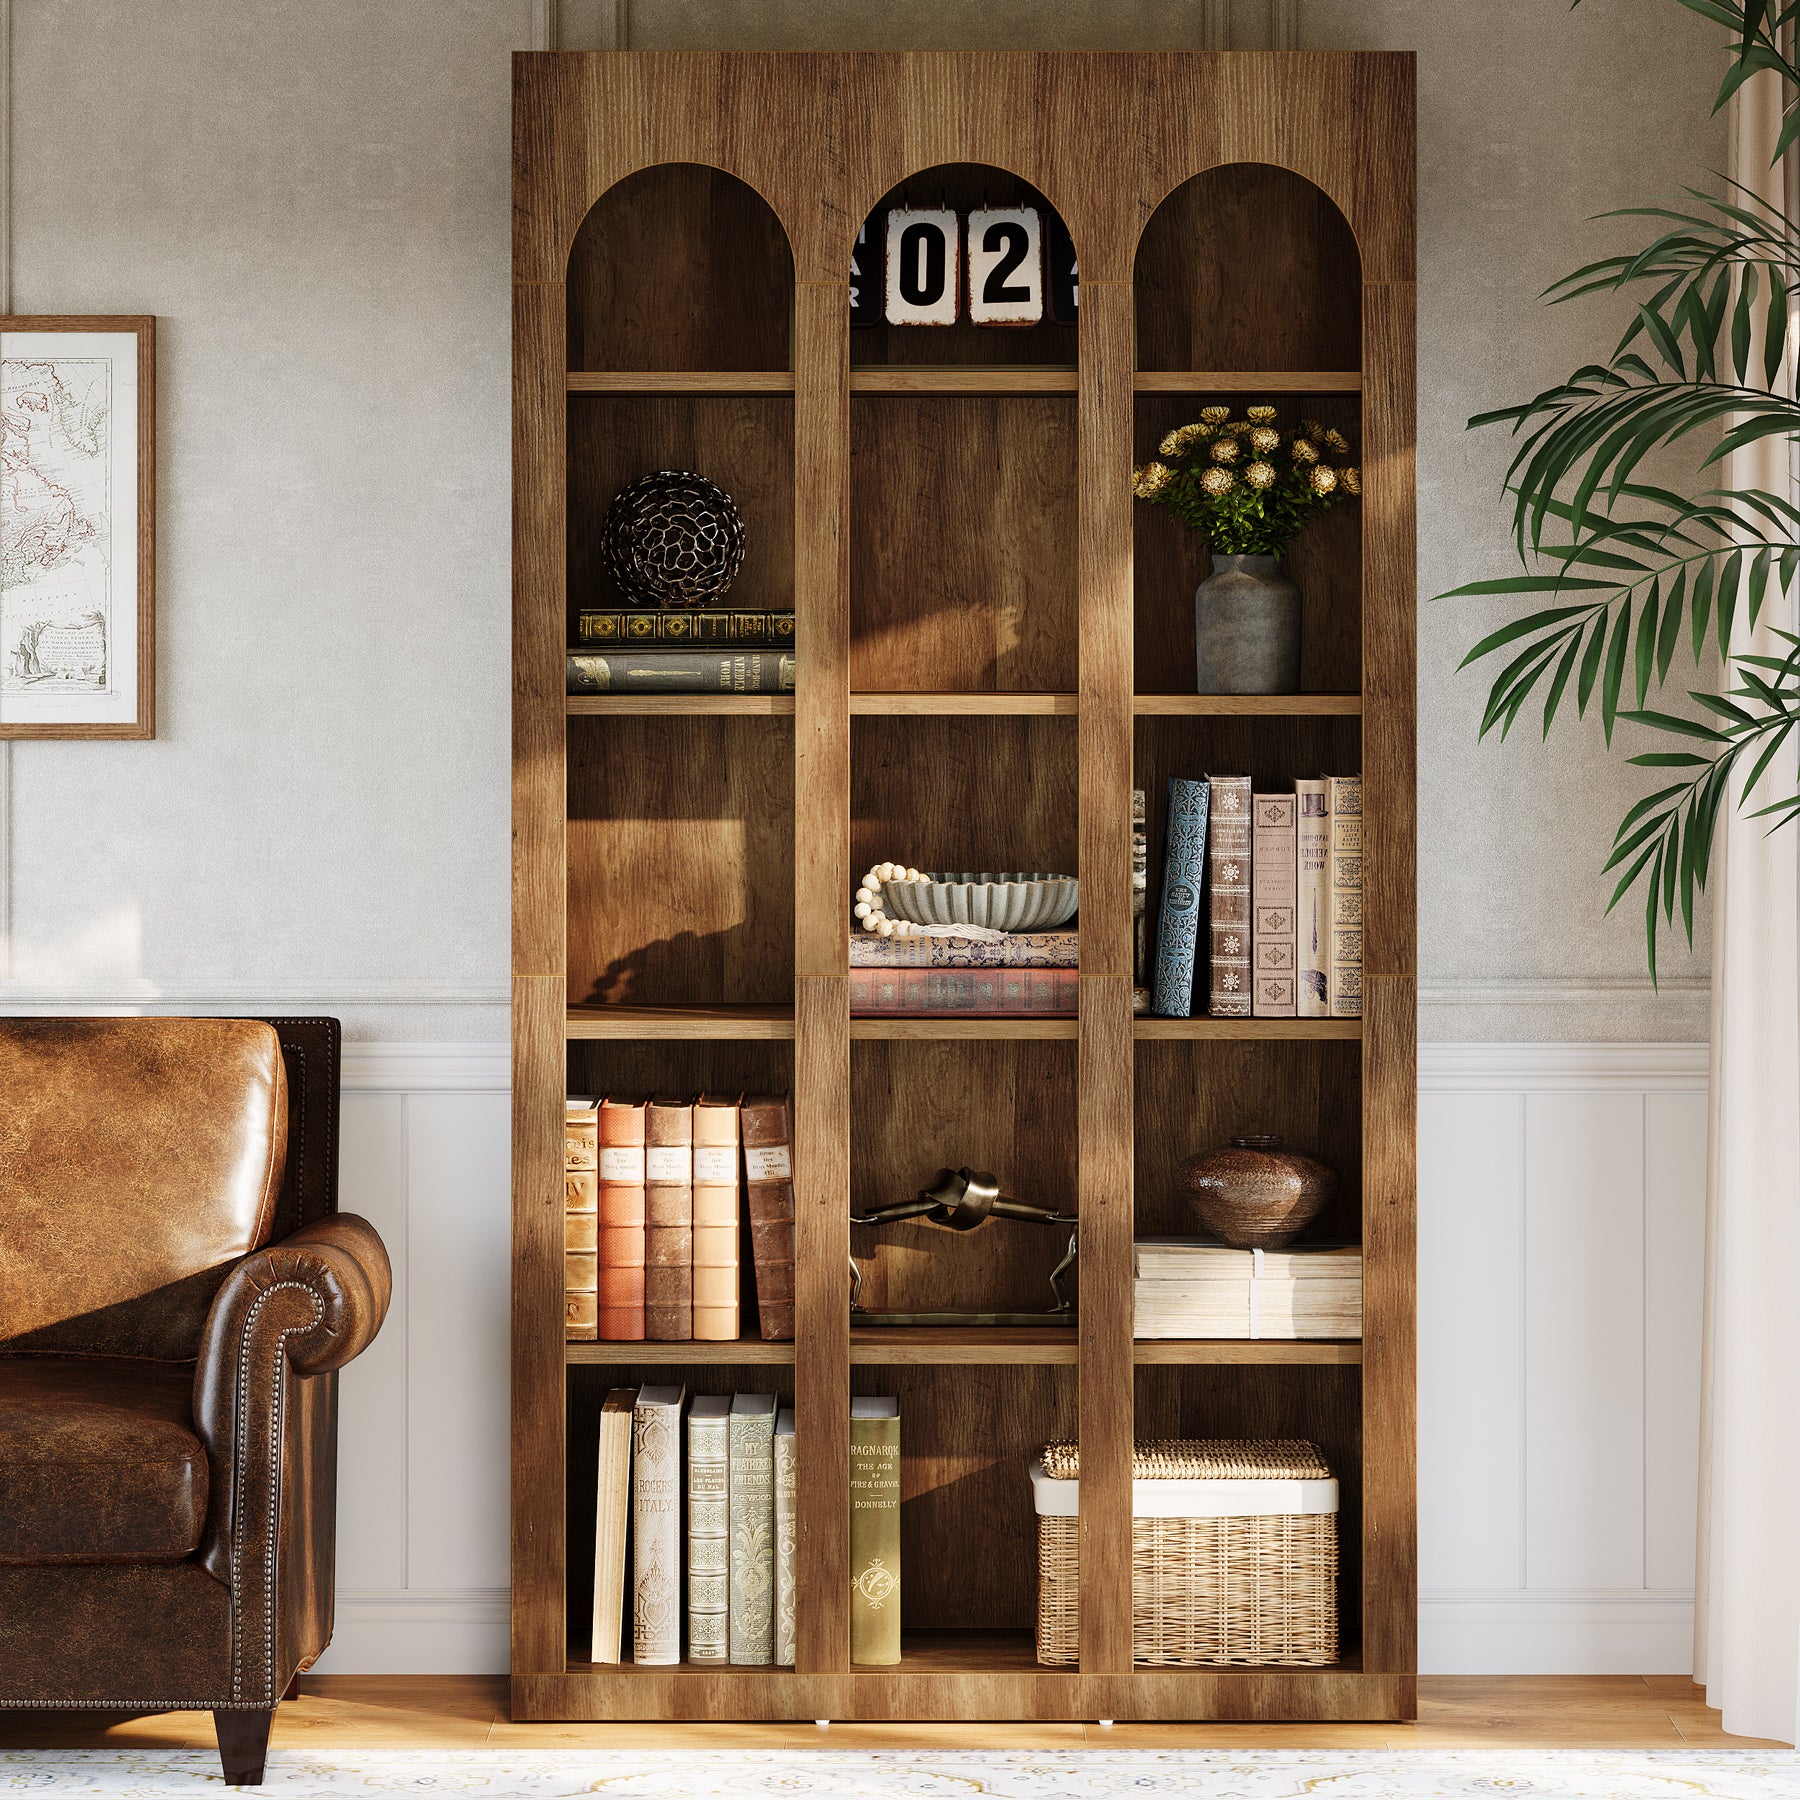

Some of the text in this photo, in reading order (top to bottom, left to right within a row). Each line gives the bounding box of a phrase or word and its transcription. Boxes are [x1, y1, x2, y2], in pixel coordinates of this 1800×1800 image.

[720, 660, 731, 686] WORK
[752, 654, 760, 691] HAND-BOO
[744, 1442, 760, 1455] MY
[854, 1500, 897, 1509] DONNELLY
